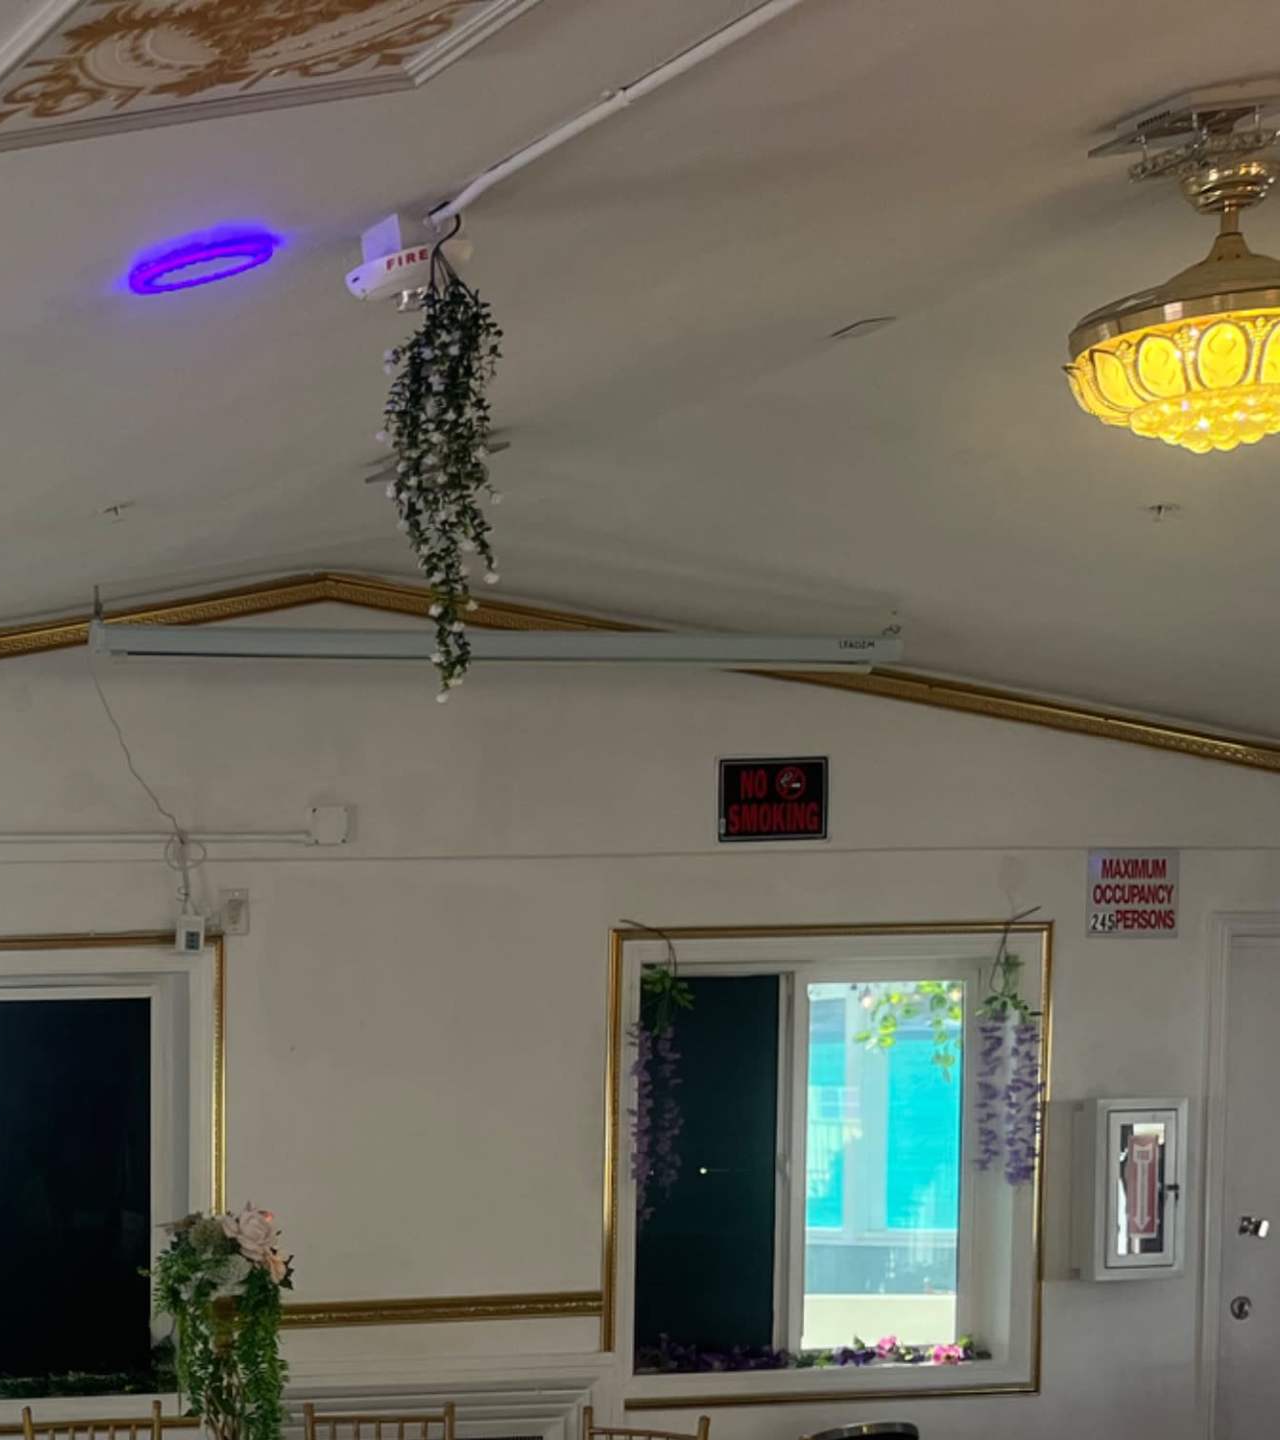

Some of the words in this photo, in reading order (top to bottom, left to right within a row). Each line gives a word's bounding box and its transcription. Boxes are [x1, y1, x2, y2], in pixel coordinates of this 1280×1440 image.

[386, 249, 428, 271] FIRE
[740, 768, 767, 800] NO
[728, 803, 819, 833] SMOKING
[1101, 859, 1166, 878] MAXIMUM
[1093, 884, 1174, 904] OCCUPANCY
[1091, 914, 1114, 930] 245
[1115, 910, 1175, 930] PERSONS
